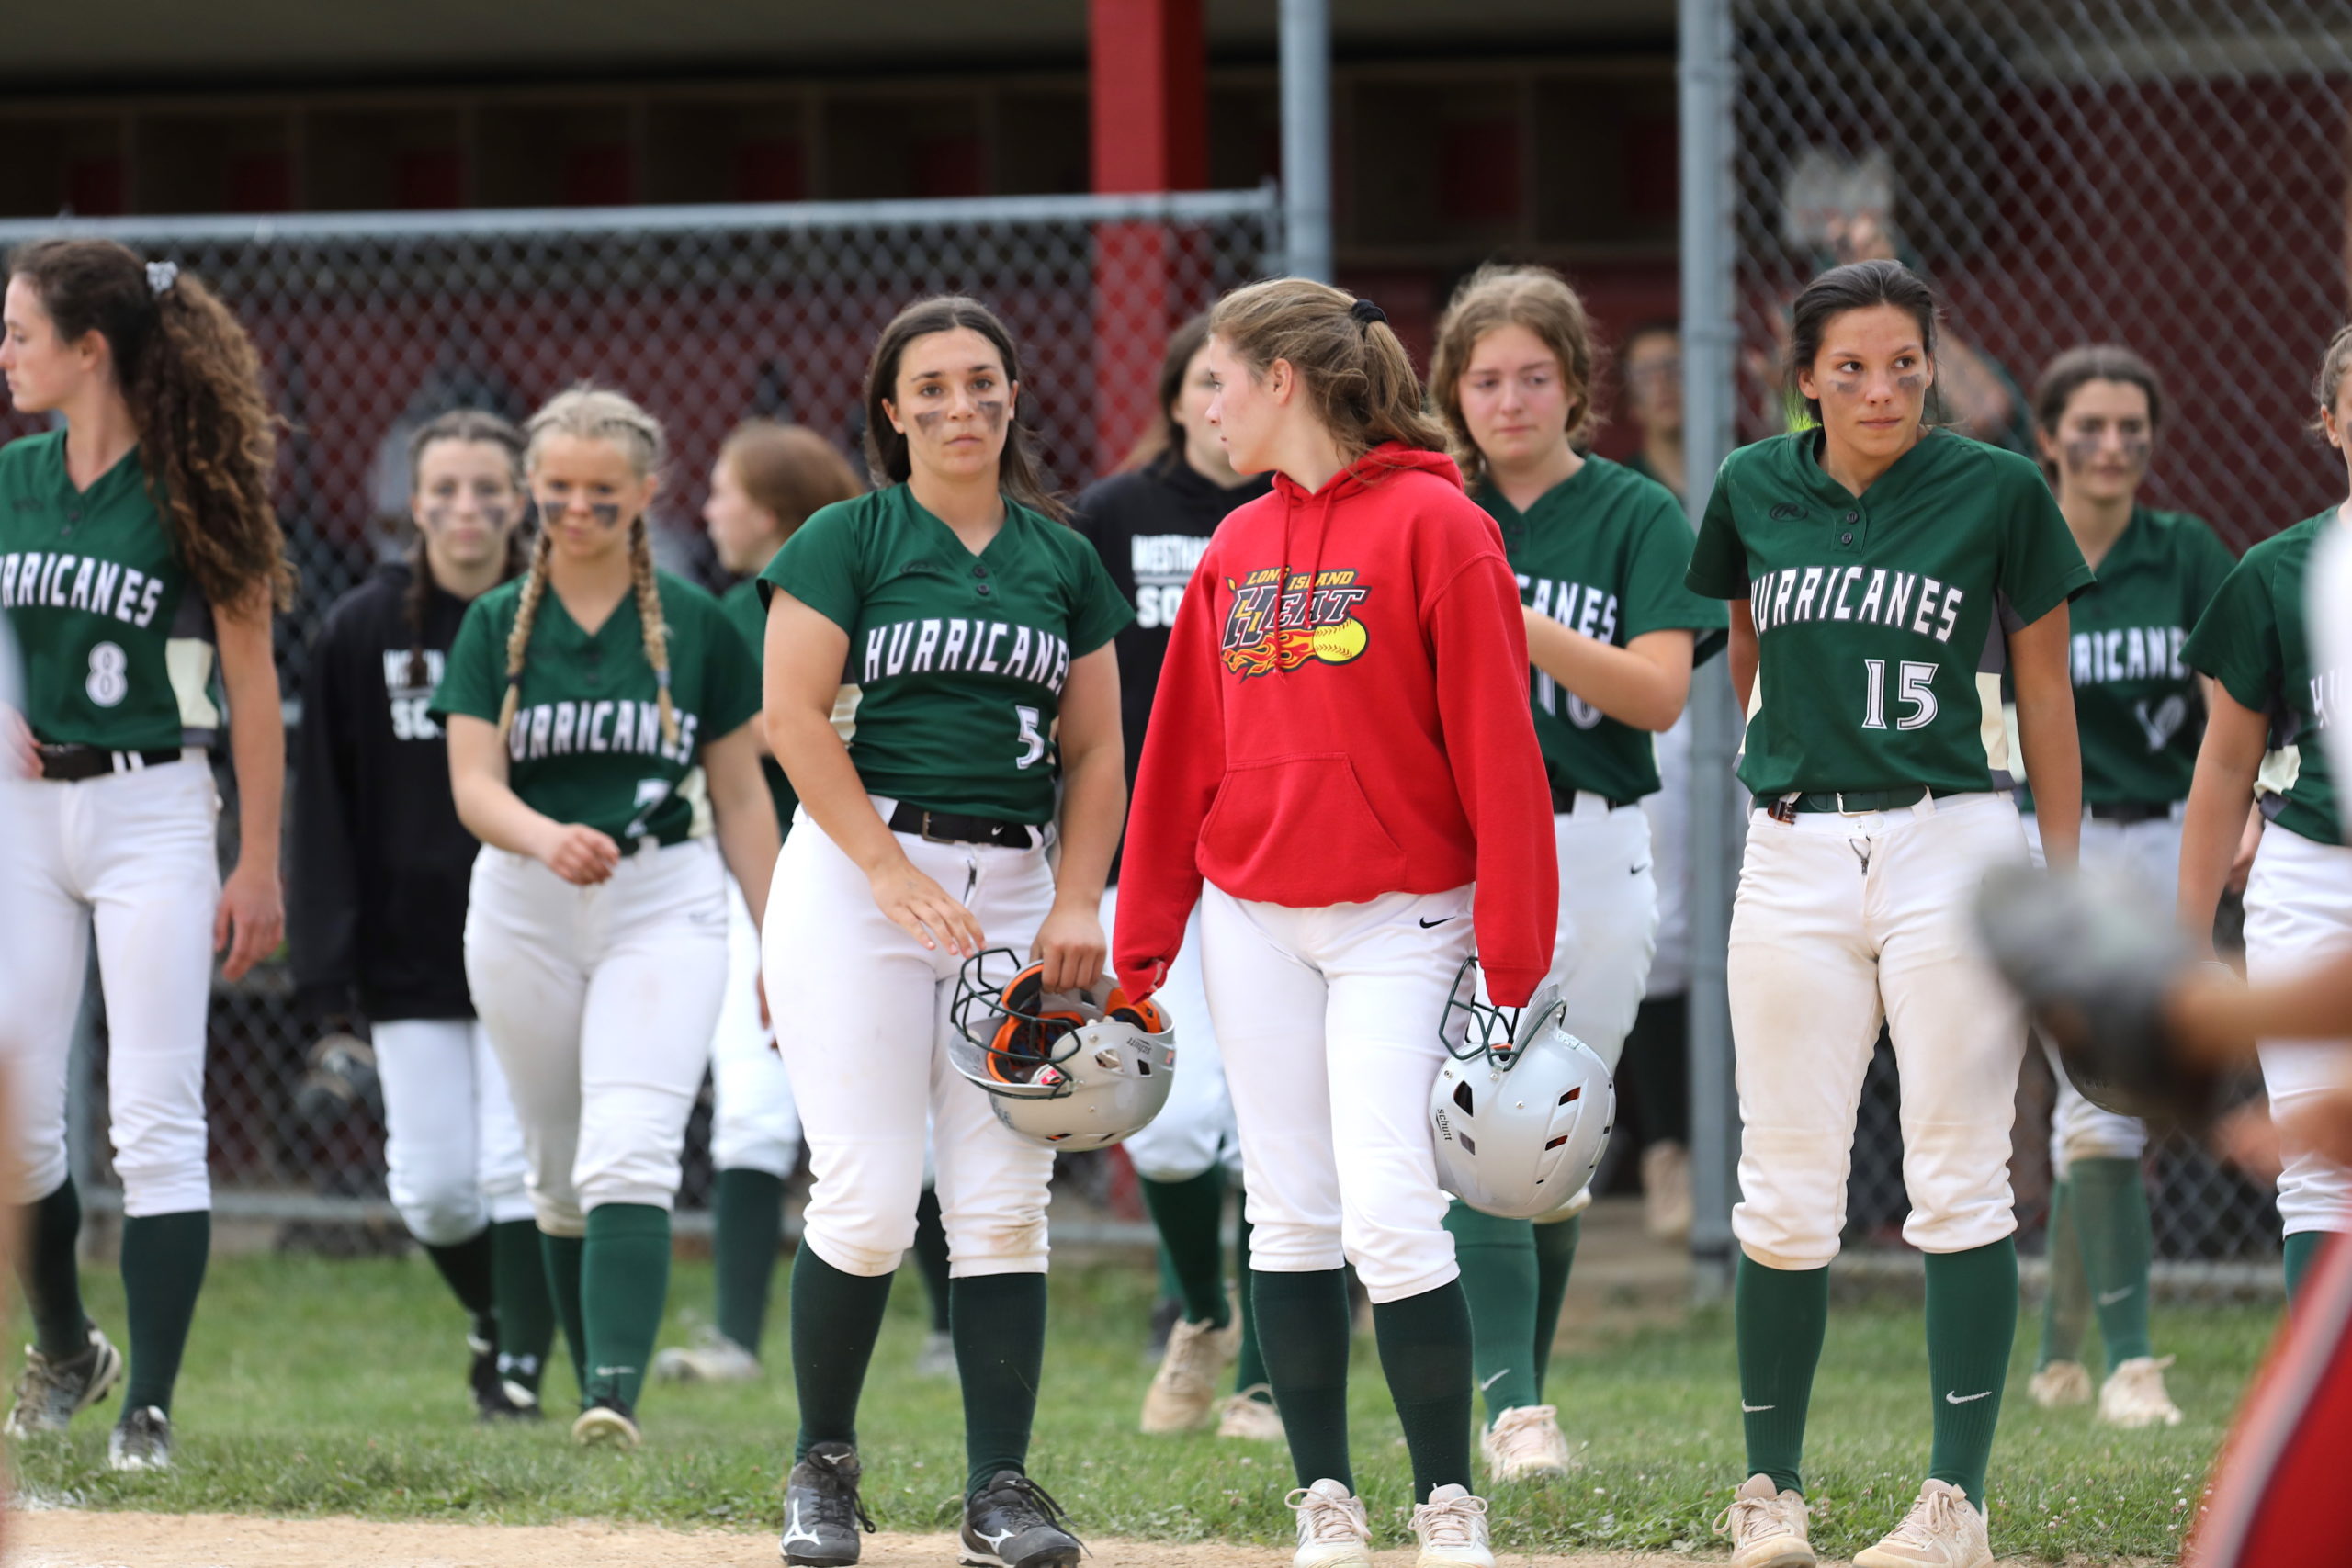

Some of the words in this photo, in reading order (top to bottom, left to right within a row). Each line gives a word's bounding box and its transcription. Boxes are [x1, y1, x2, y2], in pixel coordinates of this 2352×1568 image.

[0, 552, 164, 629] RRICANES
[1246, 567, 1291, 586] LON
[1750, 566, 1964, 643] HURRICANES
[1222, 585, 1366, 649] HEAT
[85, 640, 128, 708] 8
[1861, 658, 1939, 731] 15
[1015, 704, 1045, 770] 5
[624, 778, 673, 839] 7
